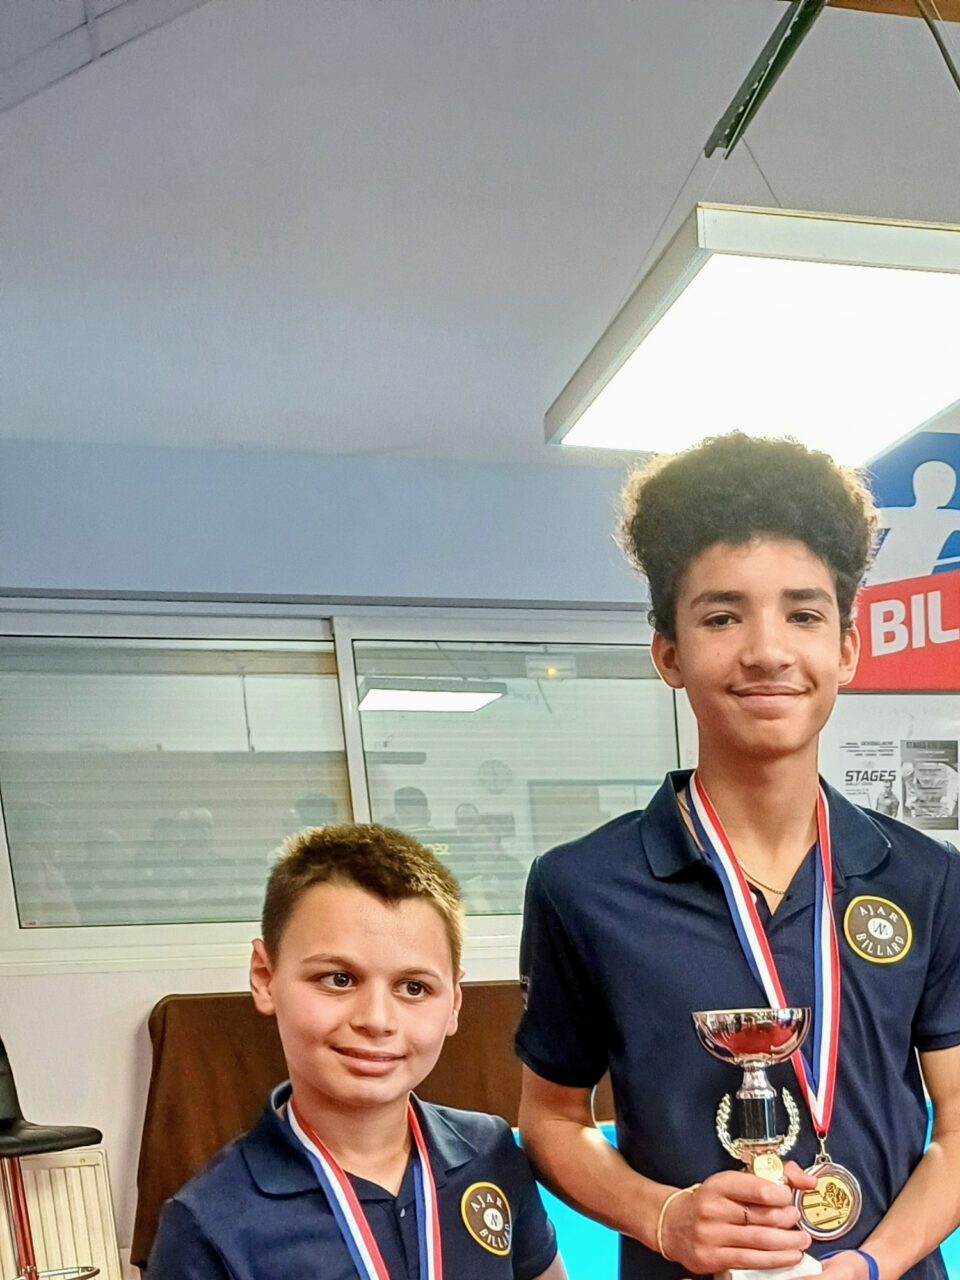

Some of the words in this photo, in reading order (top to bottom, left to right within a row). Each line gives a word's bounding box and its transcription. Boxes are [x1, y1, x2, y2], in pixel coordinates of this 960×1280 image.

[845, 770, 896, 782] STAGES
[858, 904, 899, 923] AJAR
[855, 932, 905, 957] BILLARD
[470, 1193, 503, 1213] AJAR
